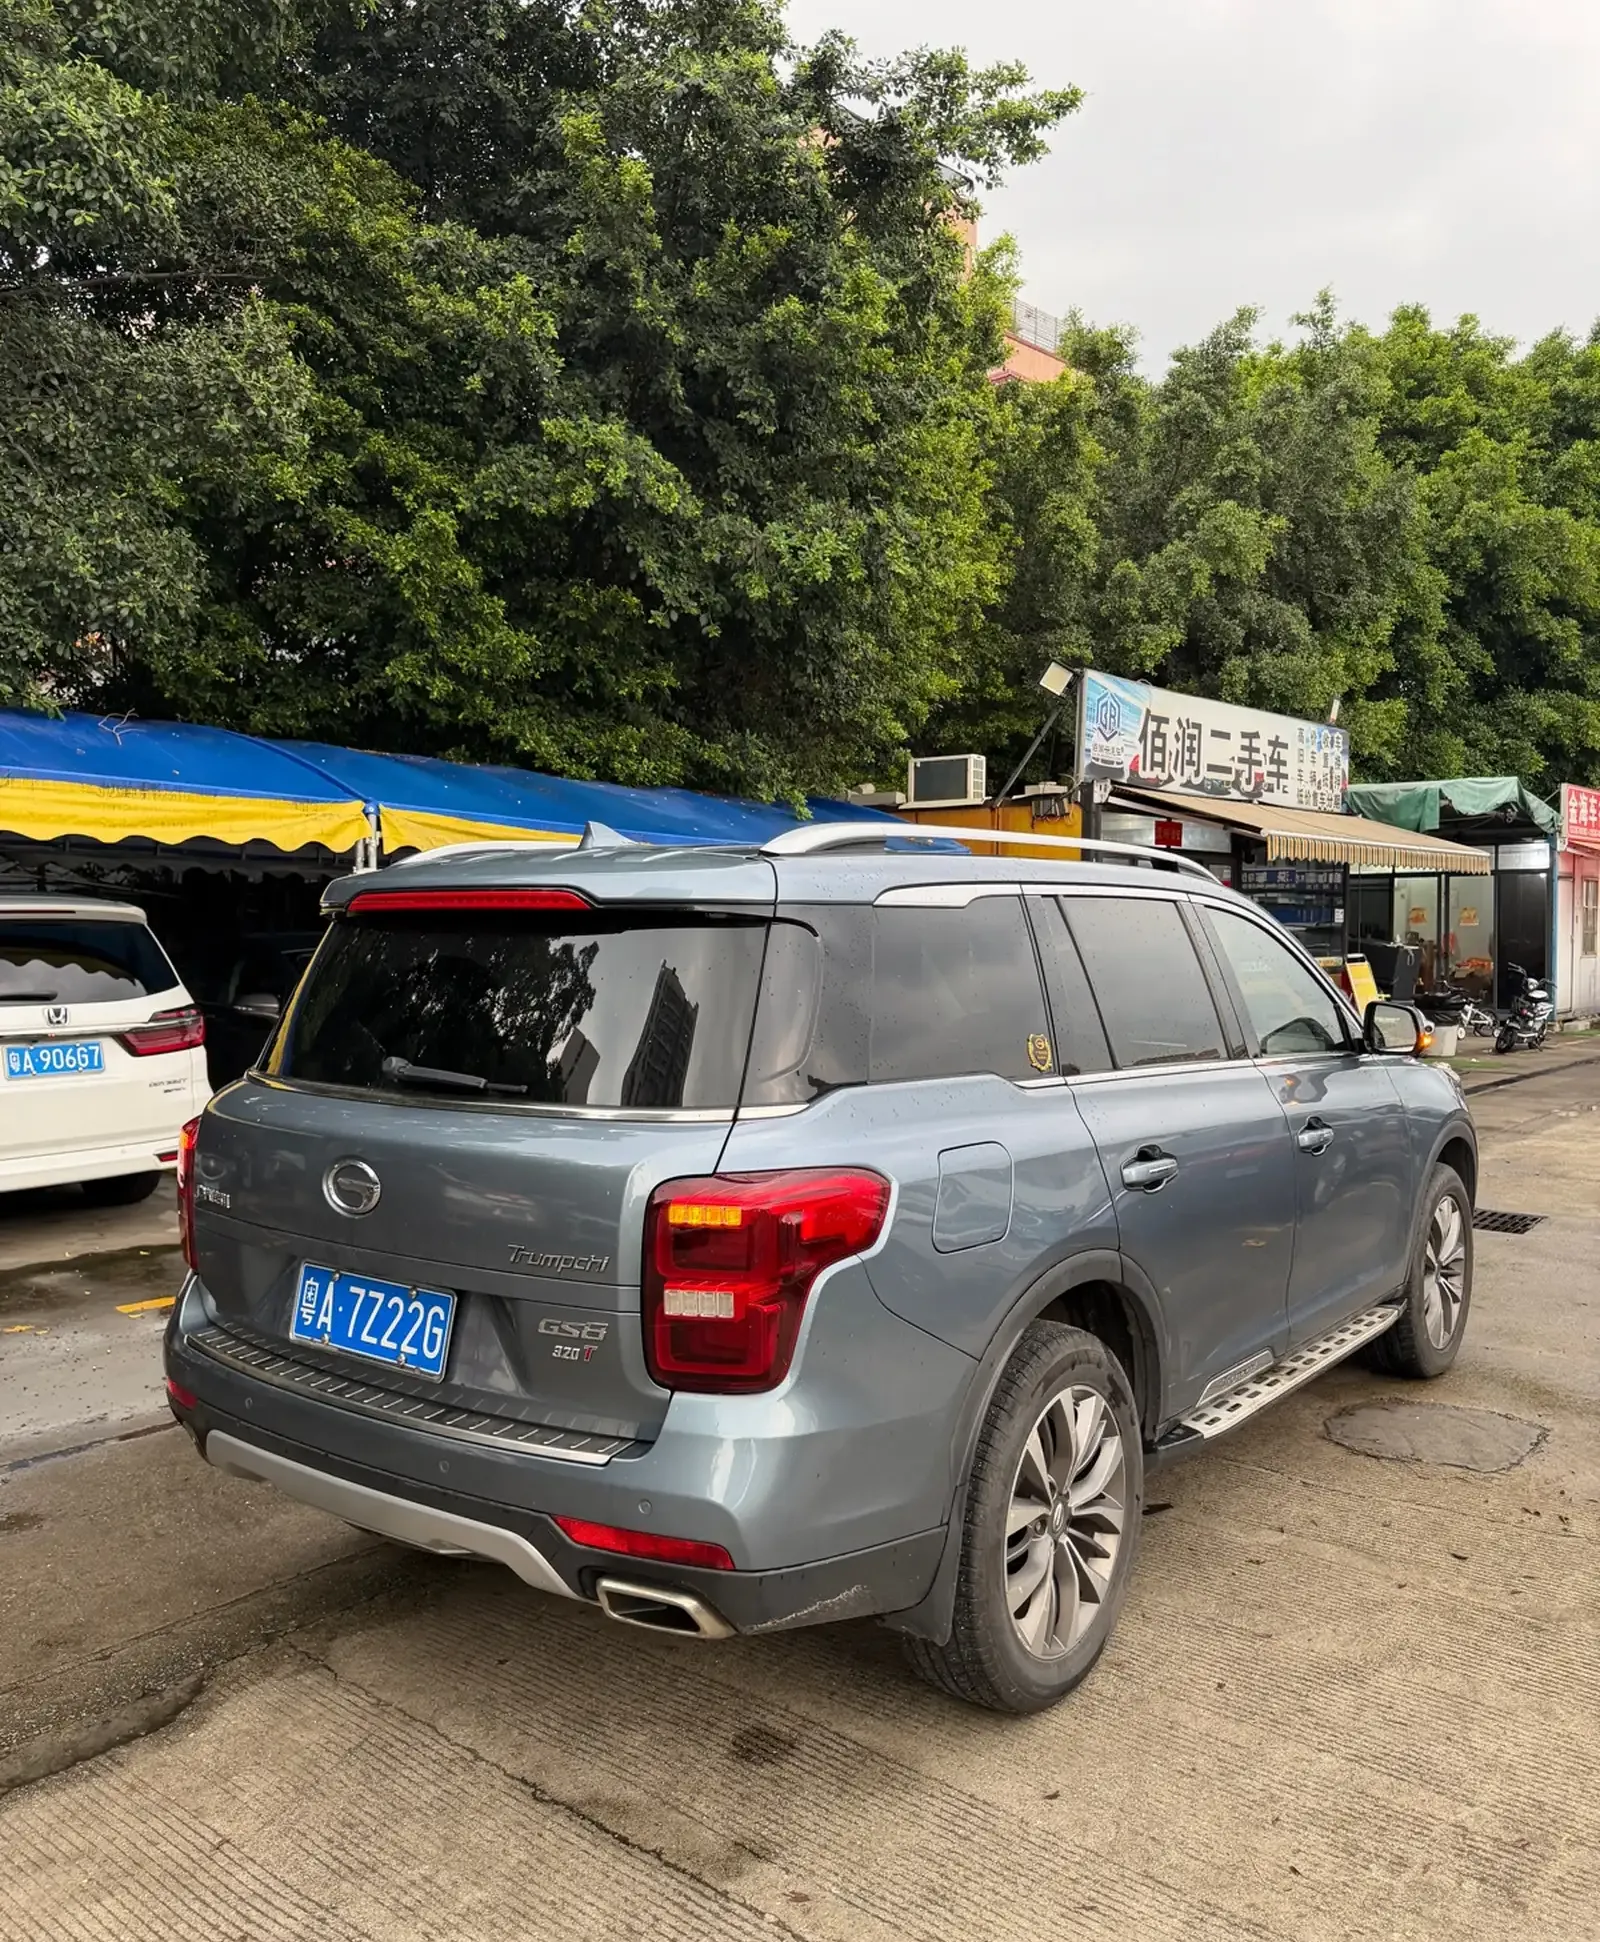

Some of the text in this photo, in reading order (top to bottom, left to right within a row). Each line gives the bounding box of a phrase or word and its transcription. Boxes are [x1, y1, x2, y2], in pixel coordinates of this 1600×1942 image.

[1138, 708, 1289, 794] 佰润二手车
[508, 1244, 610, 1273] Trumpchi
[300, 1277, 446, 1359] 粤A·7Z22G
[538, 1317, 609, 1341] GS8
